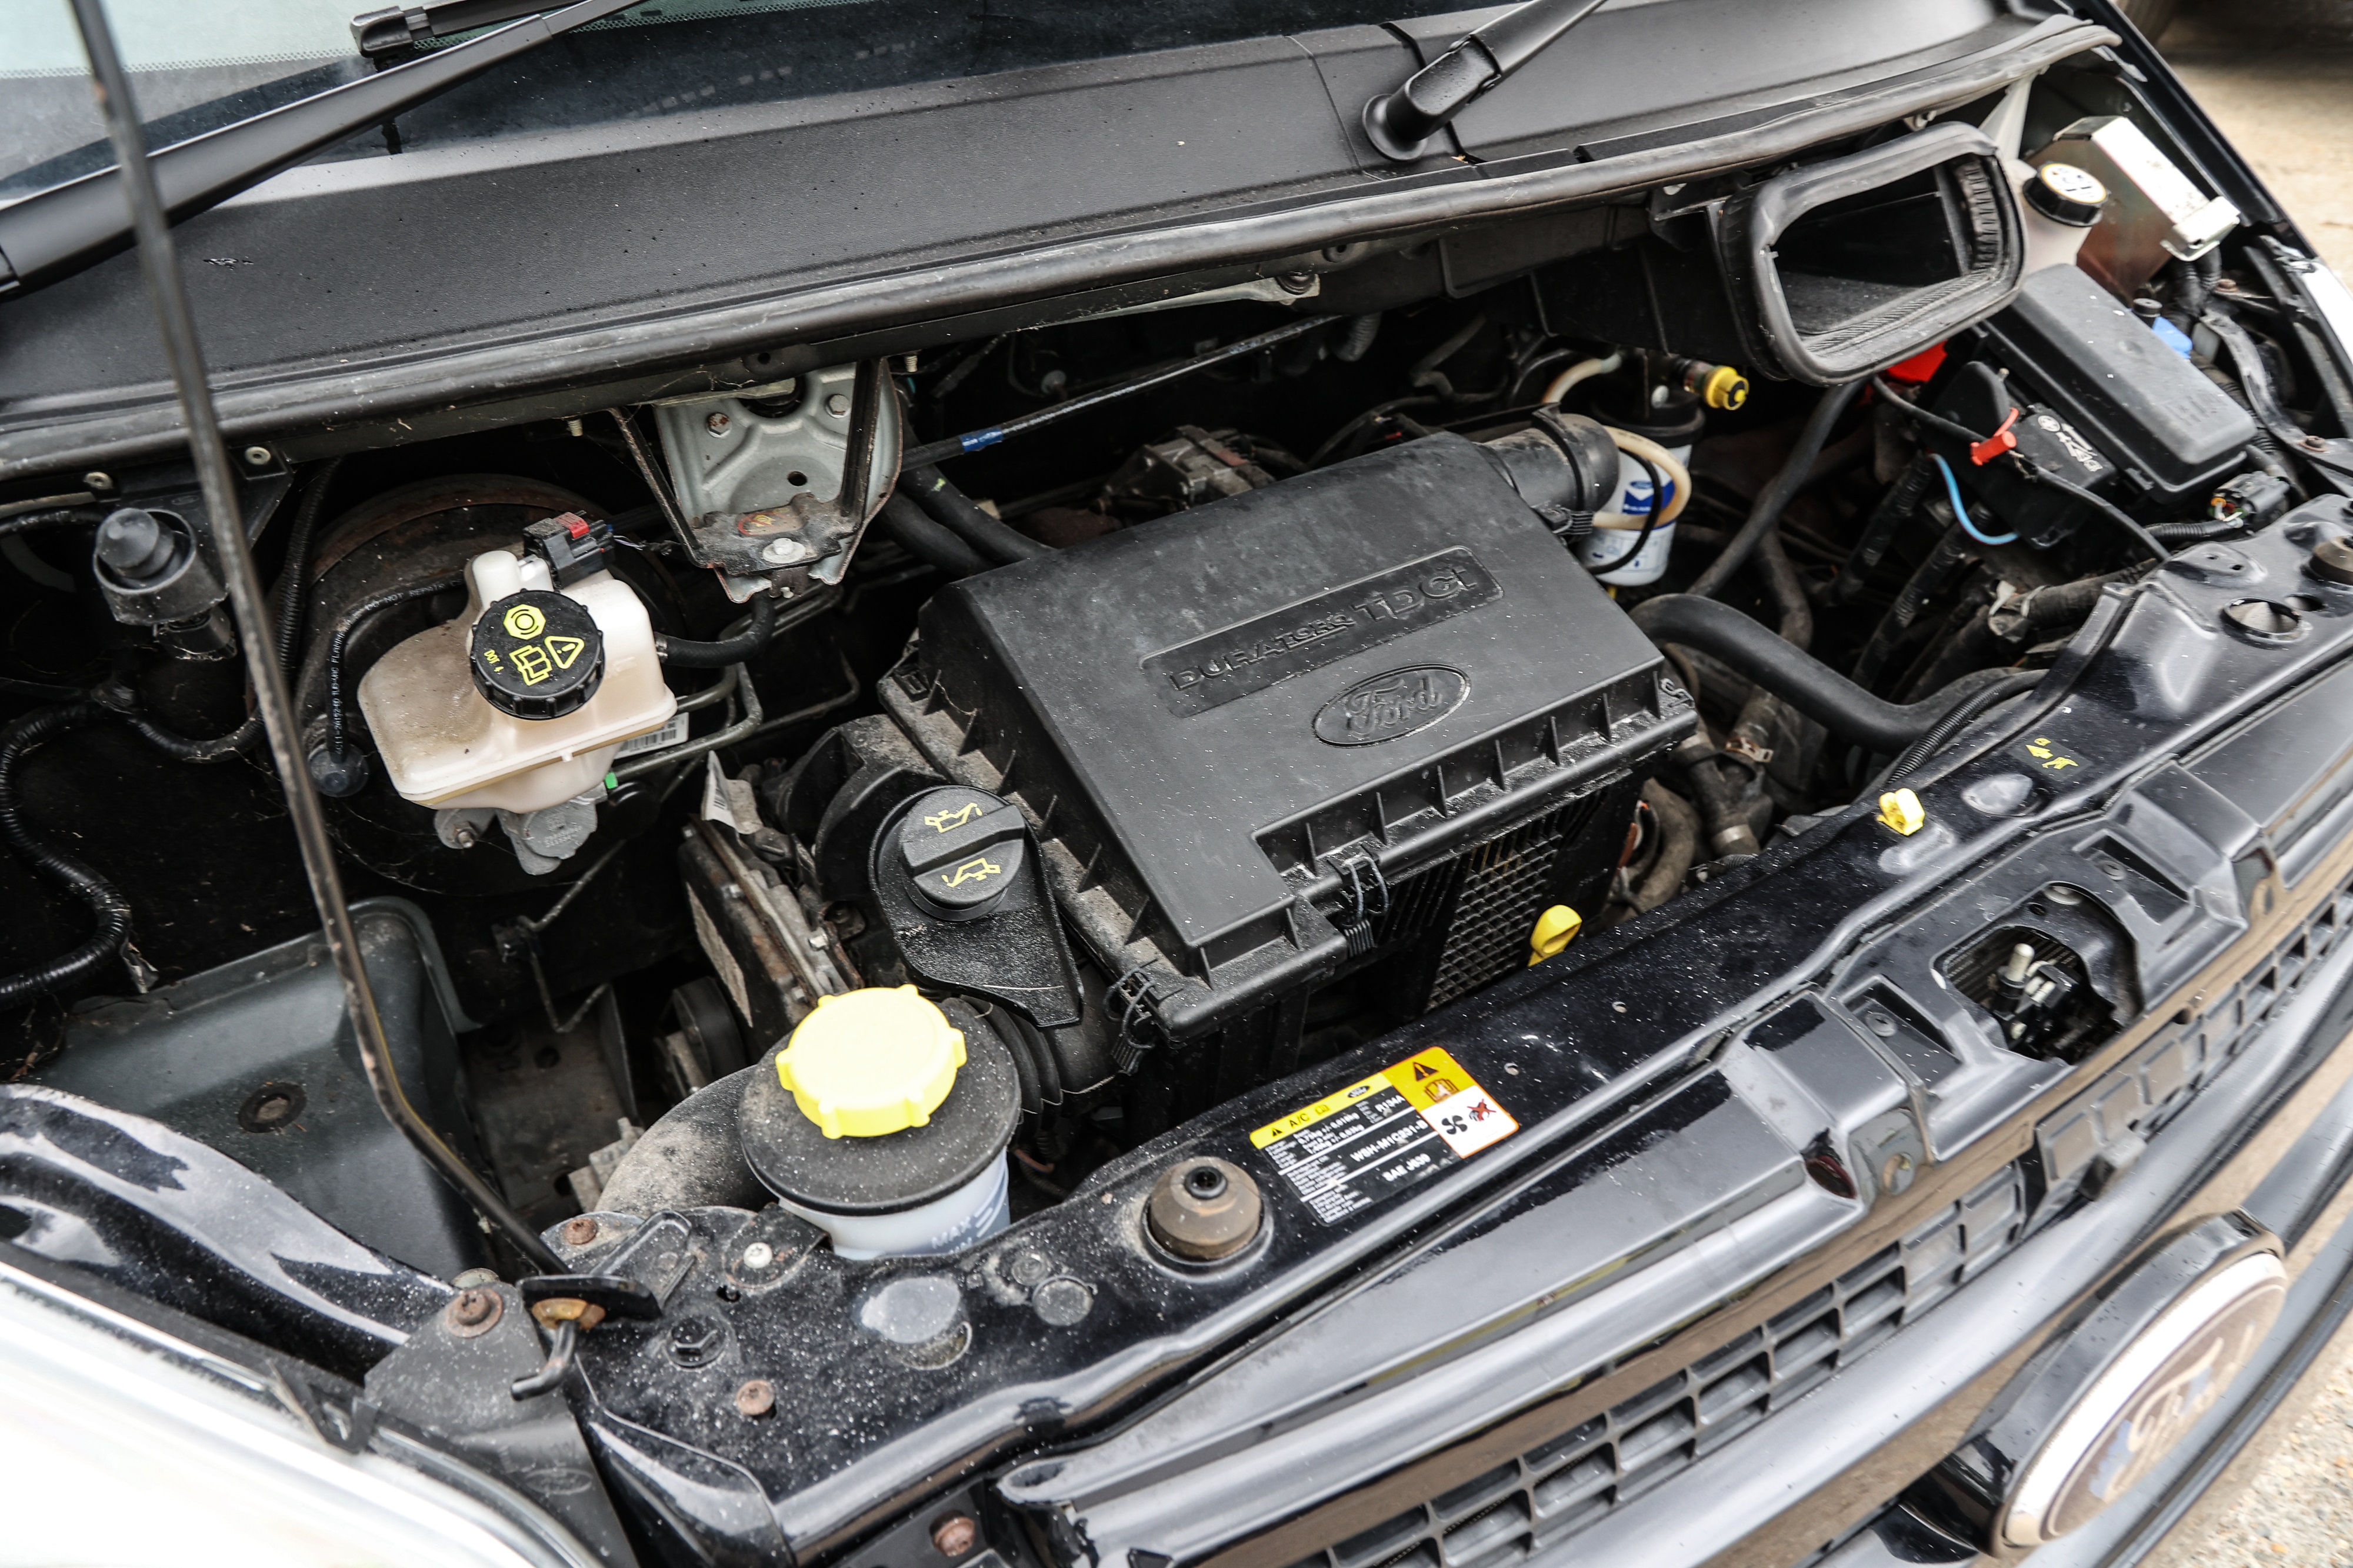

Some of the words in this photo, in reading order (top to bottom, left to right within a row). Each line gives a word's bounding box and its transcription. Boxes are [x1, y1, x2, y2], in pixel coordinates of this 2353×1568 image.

[484, 649, 500, 664] DOT
[1345, 675, 1442, 740] Ford
[1289, 1113, 1310, 1128] A/C
[1381, 1165, 1409, 1182] SAE
[931, 1216, 972, 1249] MAX
